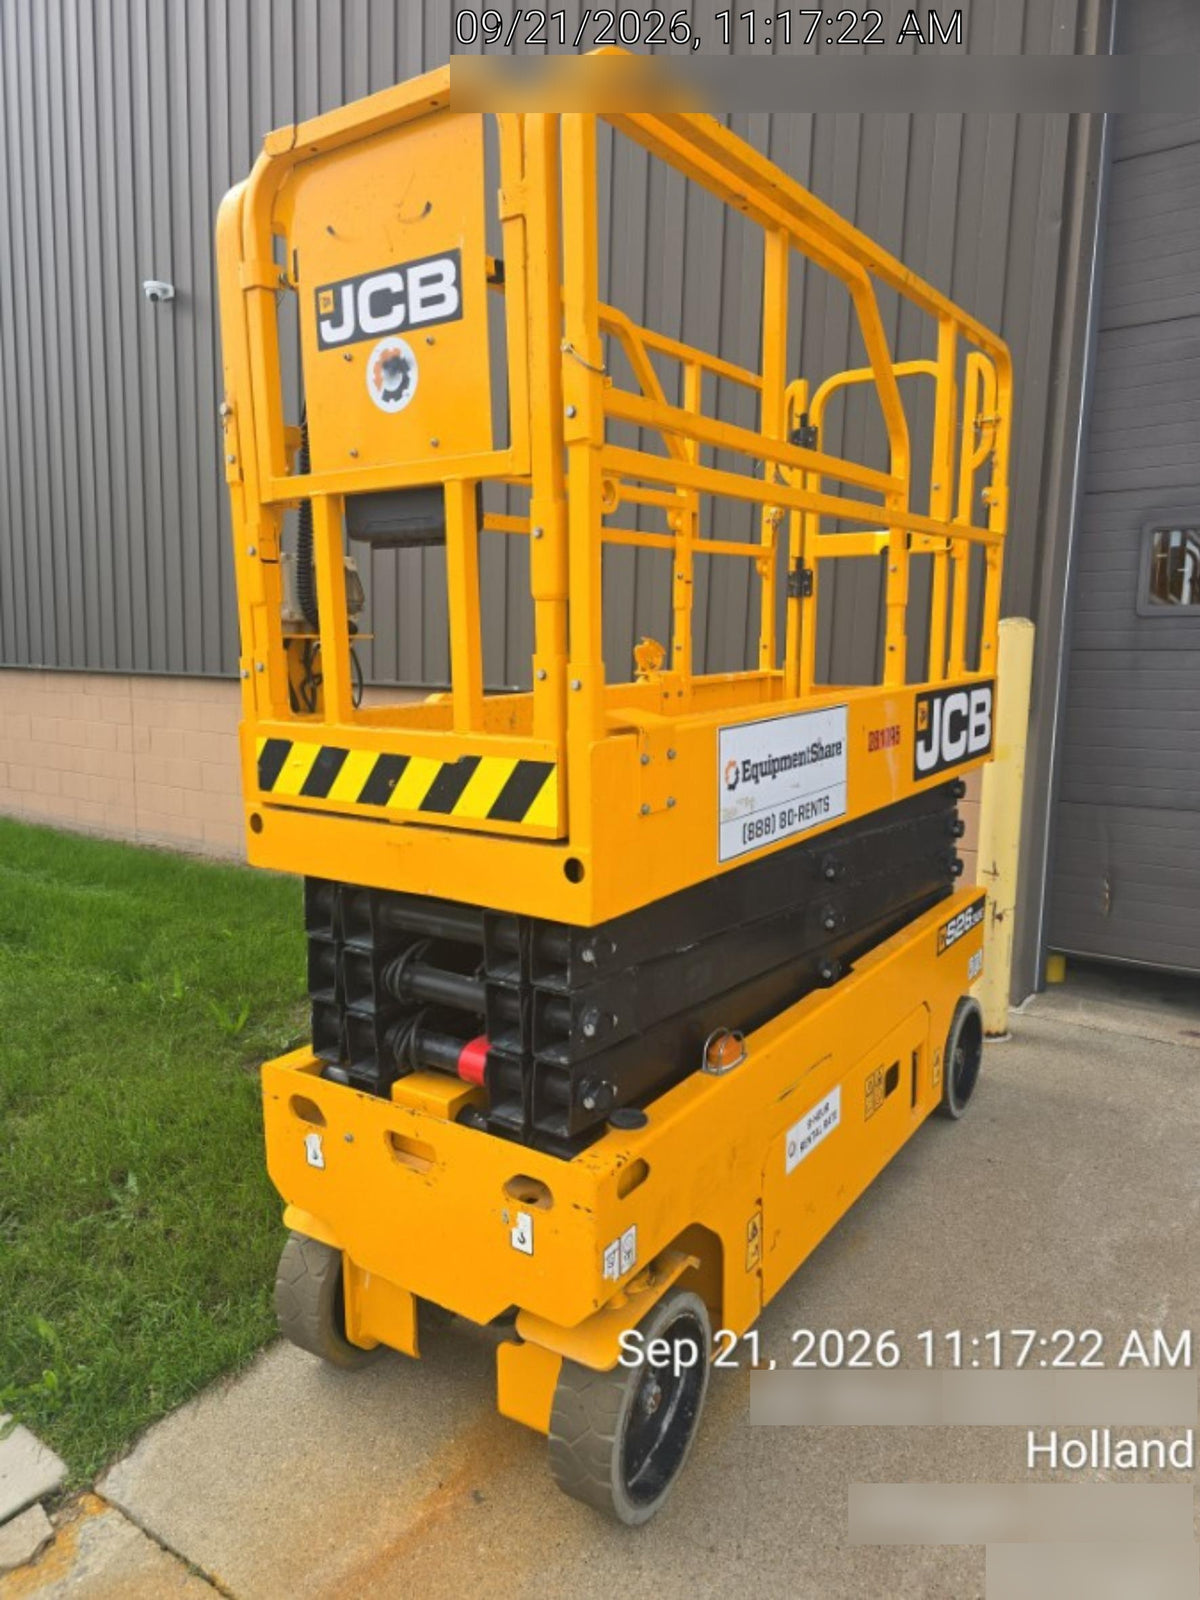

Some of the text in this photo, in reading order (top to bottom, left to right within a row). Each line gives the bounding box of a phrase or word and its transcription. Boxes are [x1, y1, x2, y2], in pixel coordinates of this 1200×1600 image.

[320, 257, 459, 344] JCB
[741, 740, 843, 784] EquipmentShare
[915, 688, 993, 772] JCB
[742, 813, 776, 846] (888)
